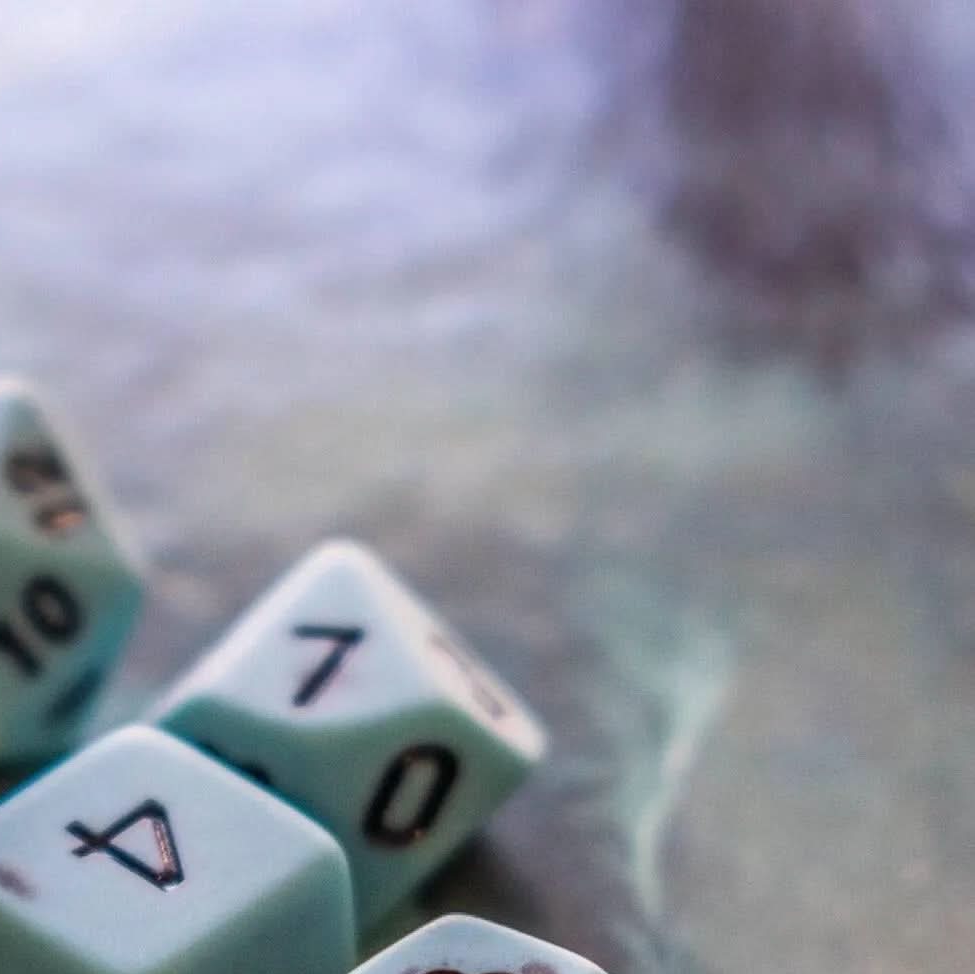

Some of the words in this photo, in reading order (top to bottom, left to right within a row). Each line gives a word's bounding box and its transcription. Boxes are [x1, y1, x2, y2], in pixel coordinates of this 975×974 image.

[292, 623, 364, 707] 7
[362, 743, 461, 849] 0
[65, 798, 184, 891] 4
